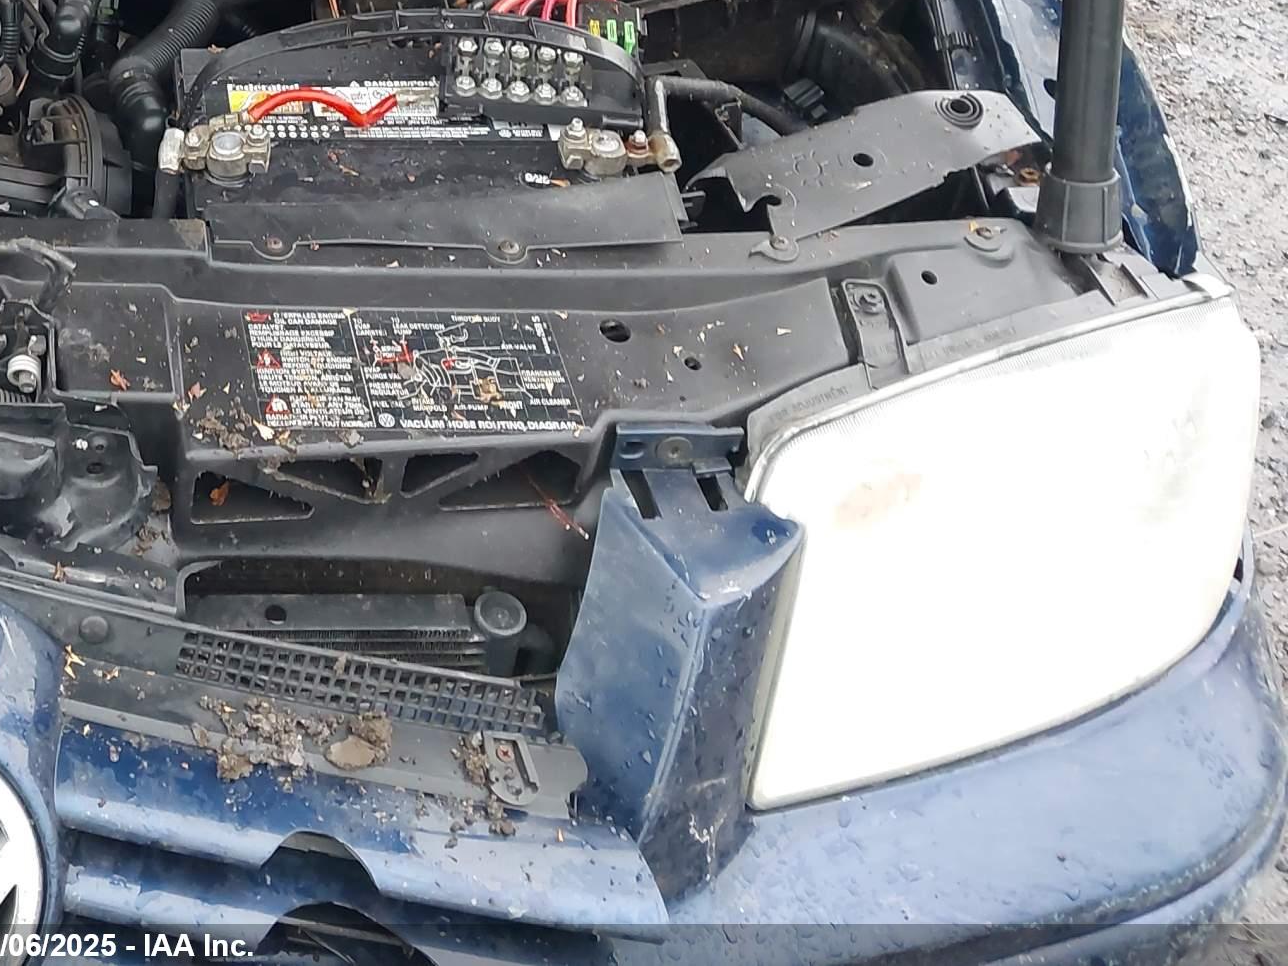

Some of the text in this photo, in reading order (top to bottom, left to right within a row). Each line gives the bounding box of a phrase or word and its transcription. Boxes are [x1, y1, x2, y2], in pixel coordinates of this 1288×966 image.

[227, 83, 299, 91] Federated
[399, 418, 445, 428] VACUUM
[447, 420, 477, 429] HOSE
[527, 420, 577, 430] DIAGRAM
